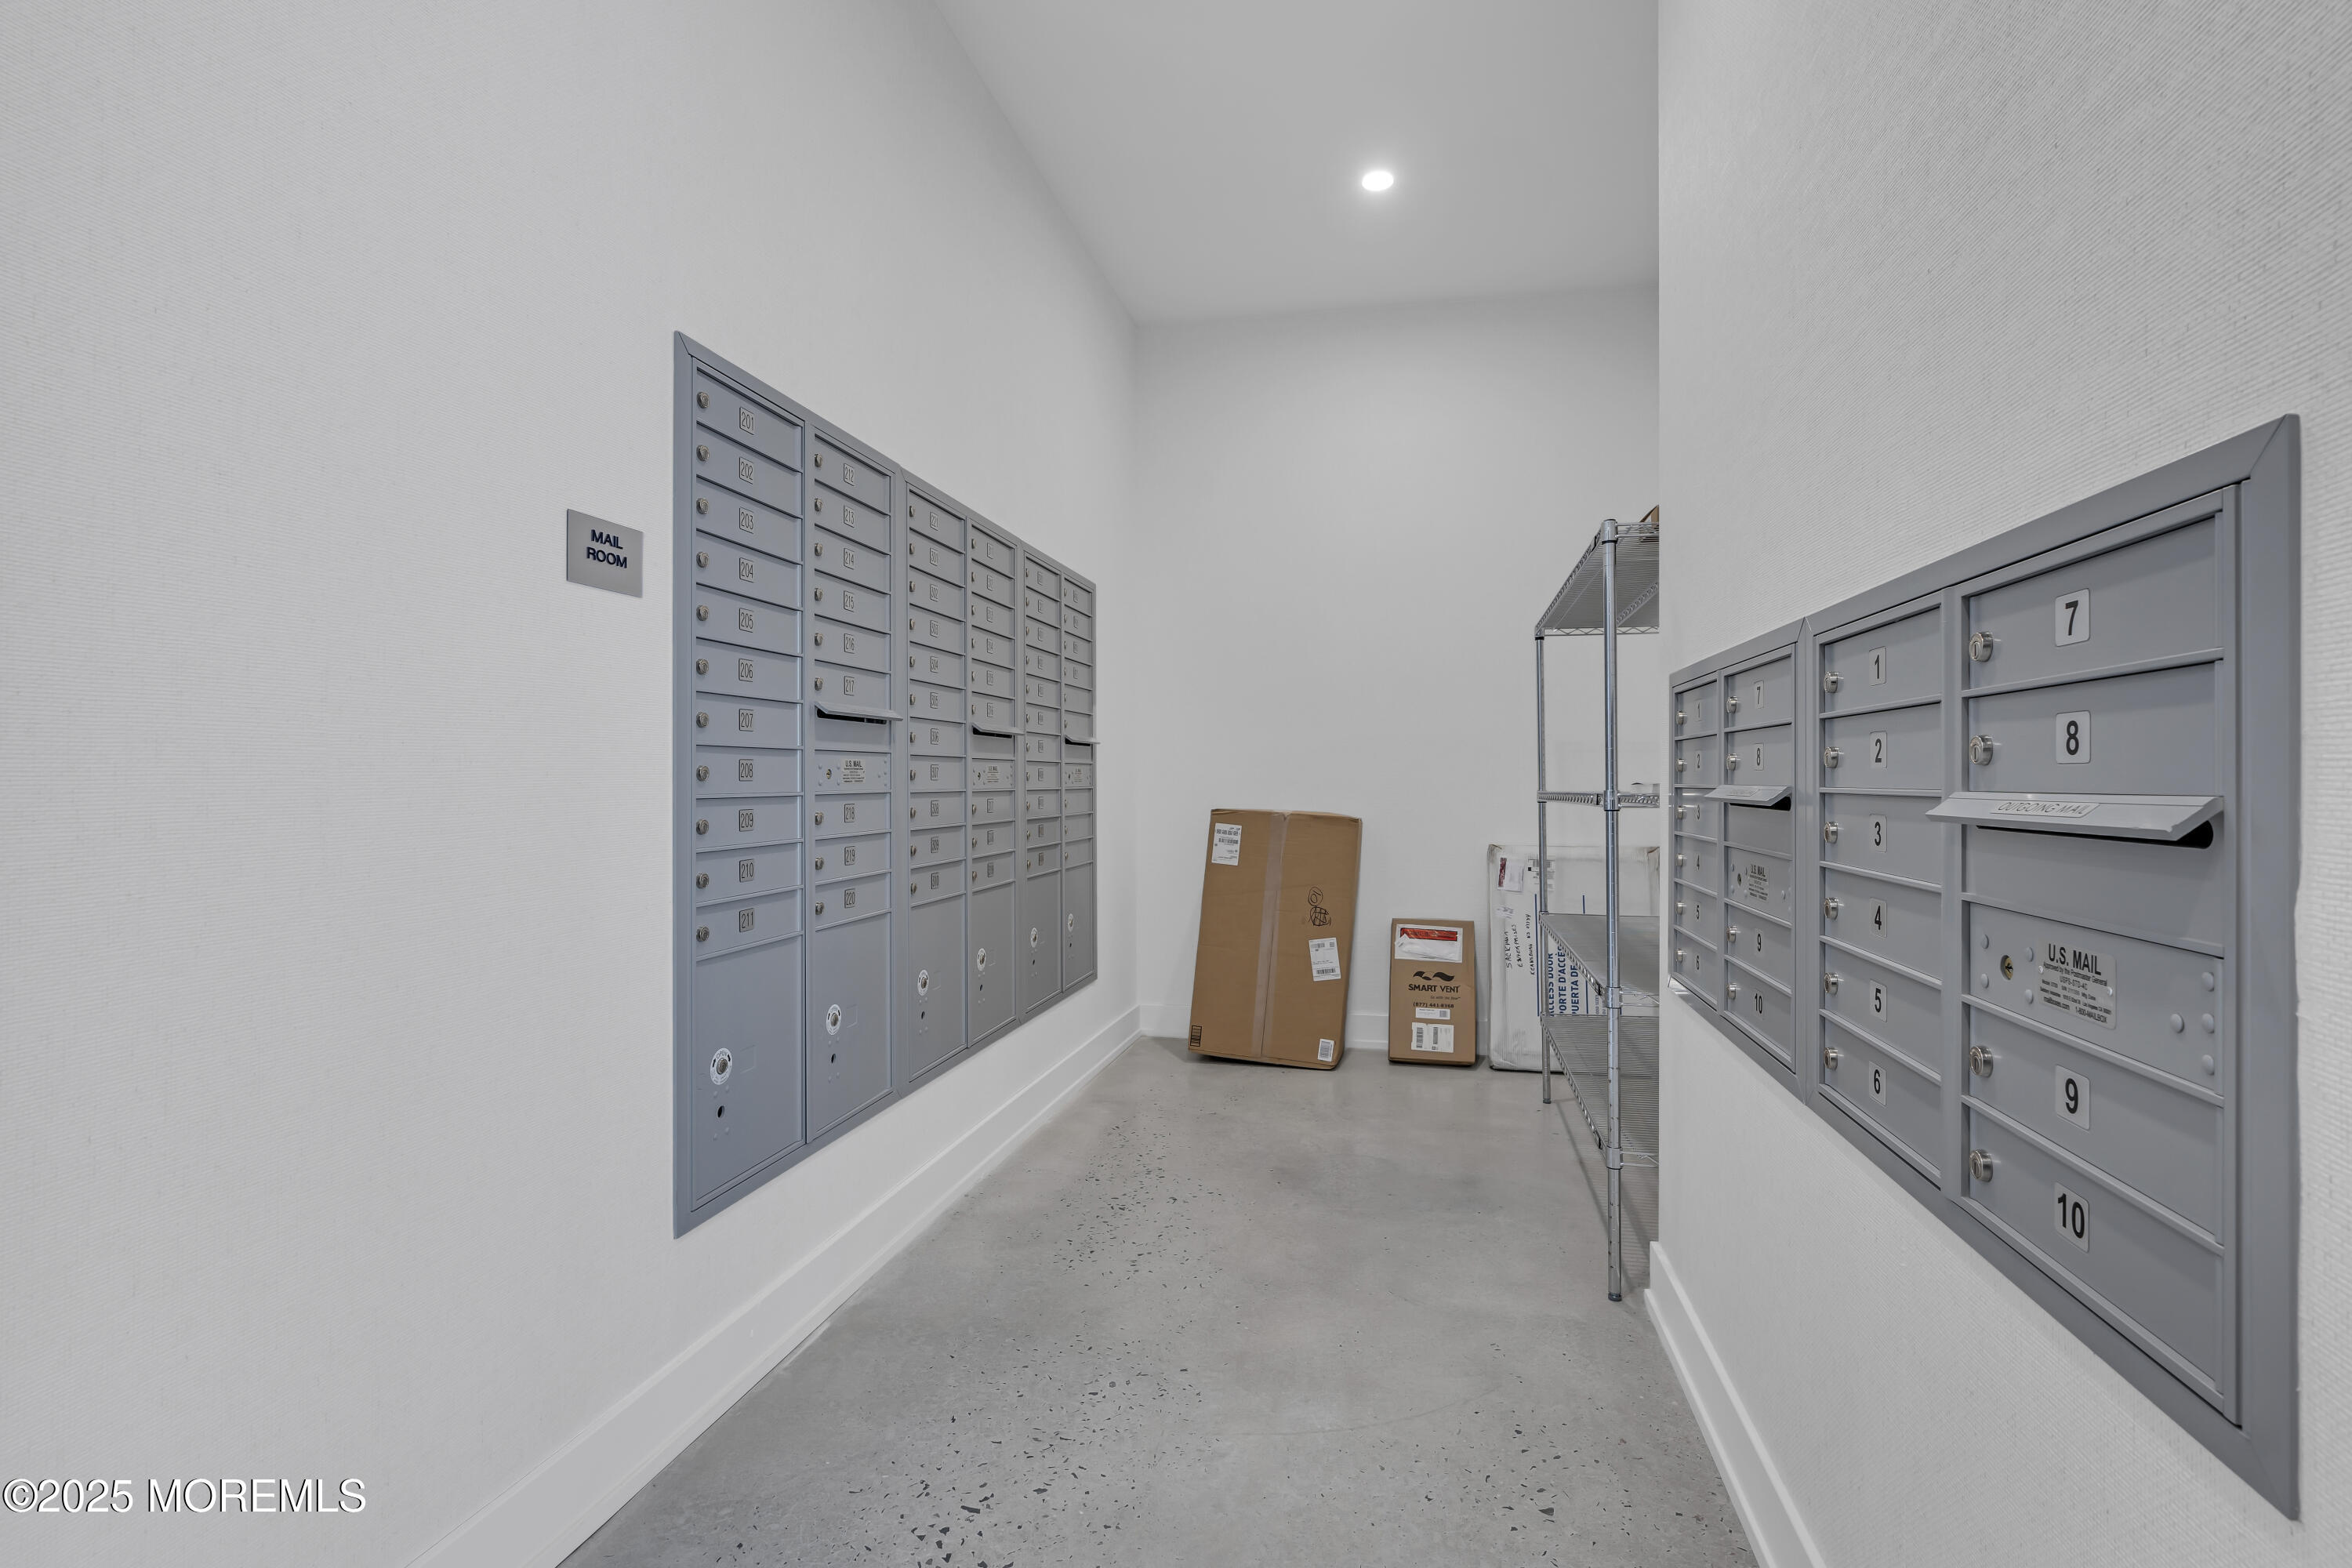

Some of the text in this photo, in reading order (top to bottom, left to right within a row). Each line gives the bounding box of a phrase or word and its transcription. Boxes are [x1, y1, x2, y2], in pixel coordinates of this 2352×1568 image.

[741, 412, 753, 430] 201
[741, 461, 753, 480] 202
[845, 465, 855, 483] 212
[741, 511, 753, 530] 203
[845, 510, 855, 527] 213
[591, 529, 623, 550] MAIL
[586, 546, 627, 568] ROOM
[845, 552, 855, 568] 214
[741, 561, 753, 579] 204
[845, 594, 855, 609] 215
[741, 613, 753, 630] 205
[2065, 600, 2078, 637] 7
[845, 637, 855, 652] 216
[741, 663, 753, 679] 206
[1875, 654, 1880, 680] 1
[845, 679, 855, 693] 217
[1756, 686, 1761, 705] 7
[1697, 703, 1700, 718] 1
[741, 713, 753, 728] 207
[2066, 720, 2079, 756] 8
[1756, 747, 1761, 766] 8
[1875, 739, 1882, 763] 2
[1697, 753, 1700, 769] 2
[741, 762, 753, 779] 208
[1697, 804, 1700, 820] 3
[1998, 801, 2092, 815] OUTGOING MAIL
[741, 813, 753, 828] 209
[1875, 822, 1882, 846] 3
[845, 849, 855, 863] 219
[1697, 855, 1700, 870] 4
[741, 863, 753, 879] 210
[845, 891, 855, 906] 220
[741, 913, 753, 928] 211
[1697, 905, 1700, 920] 5
[1875, 905, 1882, 931] 4
[1757, 933, 1762, 952] 9
[1697, 955, 1700, 970] 6
[2049, 943, 2101, 975] U.S. MAIL
[1408, 984, 1437, 993] SMART
[2092, 975, 2108, 986] General
[1558, 985, 1566, 1014] ORTE
[1570, 980, 1579, 1014] UERTA
[1755, 993, 1763, 1014] 10
[1875, 988, 1882, 1013] 5
[1874, 1069, 1881, 1094] 6
[2065, 1077, 2079, 1114] 9
[2057, 1193, 2085, 1239] 10
